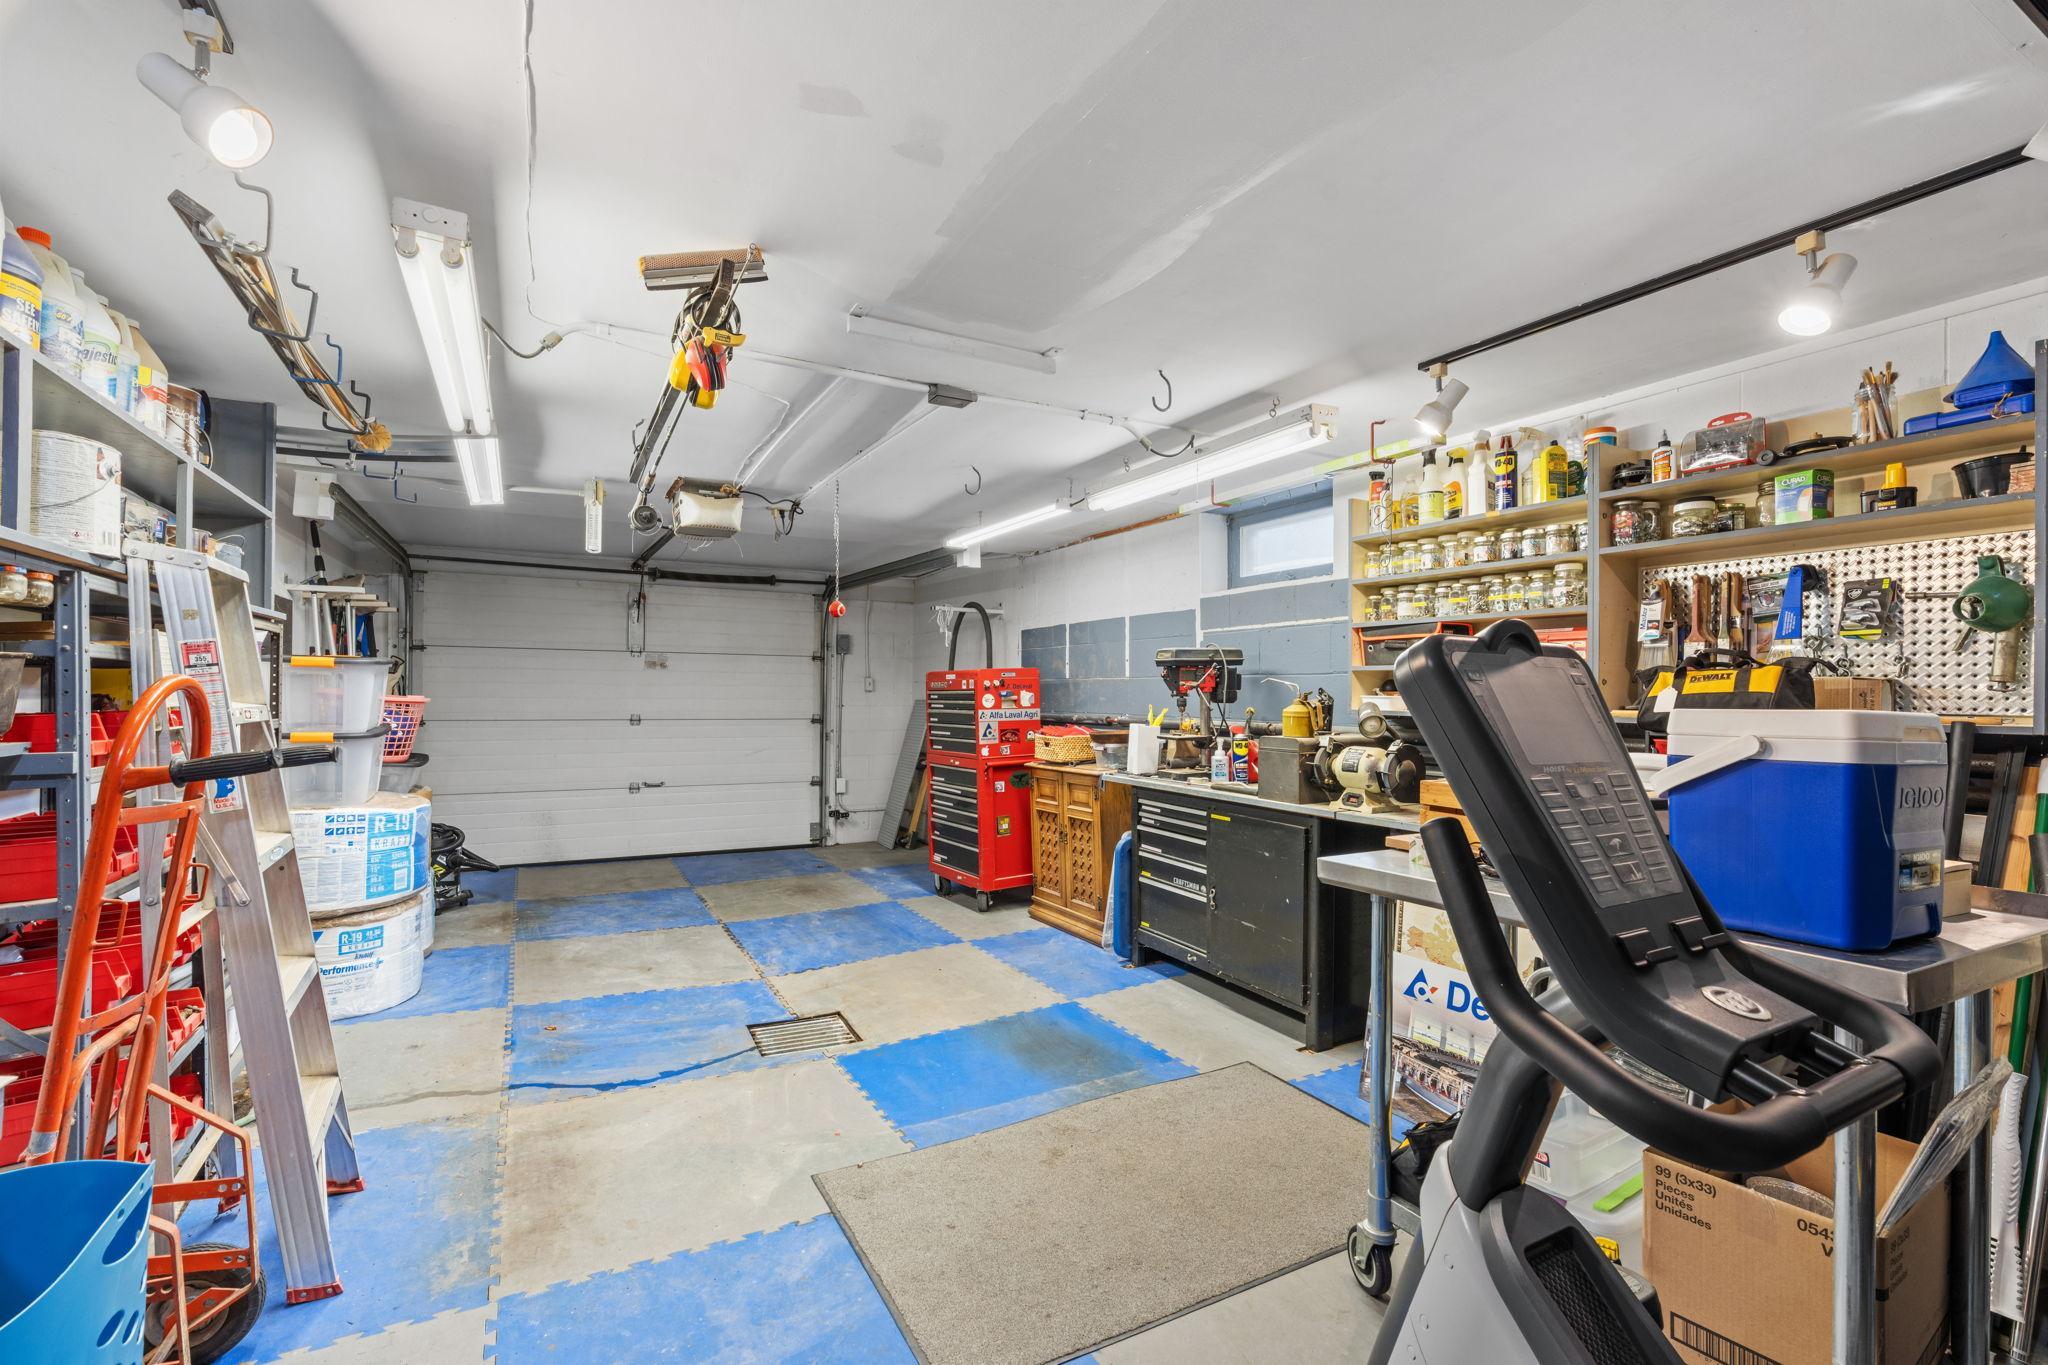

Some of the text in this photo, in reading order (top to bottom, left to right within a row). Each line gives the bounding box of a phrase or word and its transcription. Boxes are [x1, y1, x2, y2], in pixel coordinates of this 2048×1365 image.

[16, 297, 36, 317] SEE
[1781, 475, 1807, 486] CURAD
[1640, 607, 1648, 630] Master
[989, 710, 1039, 720] Alfa Laval Agri
[1899, 786, 1944, 809] IGLOO
[375, 813, 410, 834] R-19
[374, 836, 409, 849] KRAFT
[1173, 877, 1200, 891] CRAFTSMAN
[341, 931, 362, 945] R-19
[1655, 1165, 1717, 1199] 99 (3x33)
[1655, 1179, 1695, 1202] Pieces
[1655, 1189, 1694, 1212] Unités
[1655, 1200, 1712, 1231] Unidades
